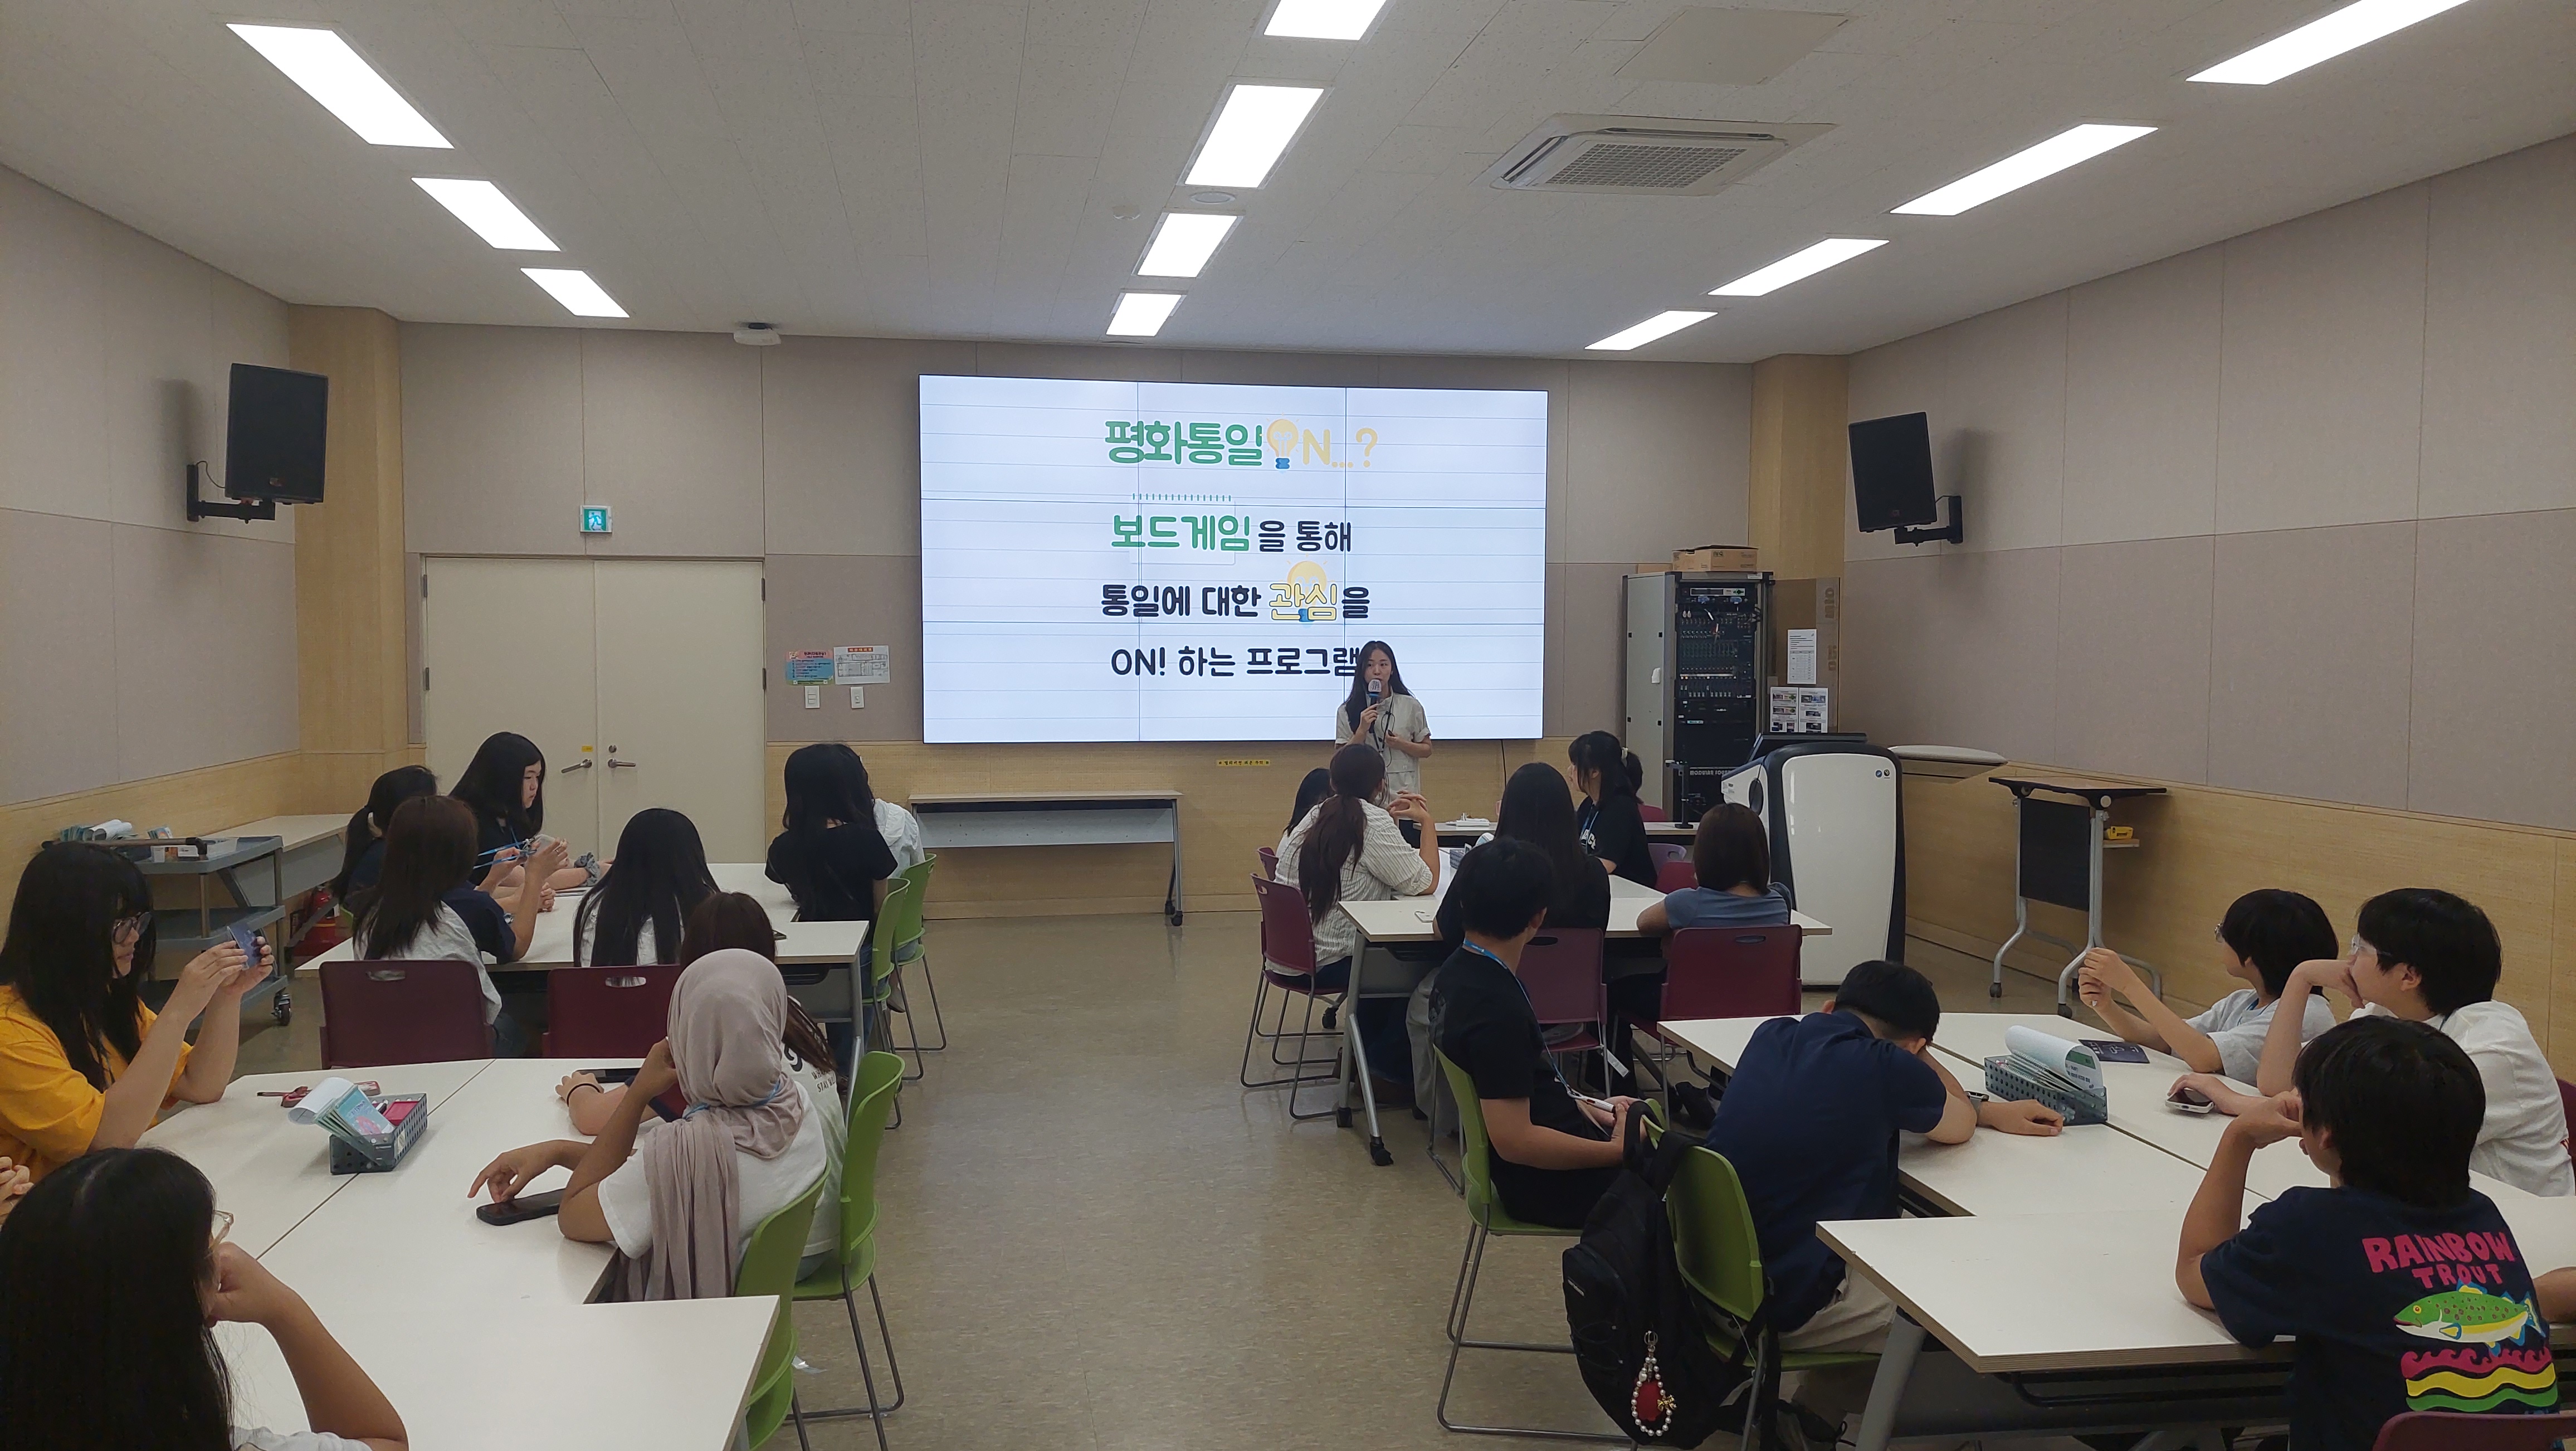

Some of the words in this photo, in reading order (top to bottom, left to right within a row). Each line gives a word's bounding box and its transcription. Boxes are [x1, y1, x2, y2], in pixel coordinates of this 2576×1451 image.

[1296, 520, 1351, 552] 통해
[1101, 584, 1191, 617] 통일에
[1202, 585, 1261, 616] 대한
[1111, 646, 1166, 676] ON!
[1178, 646, 1236, 676] 하는
[1246, 647, 1360, 676] 프로그램
[2362, 1232, 2515, 1273] RAINBOW
[2411, 1263, 2503, 1289] TROUT
